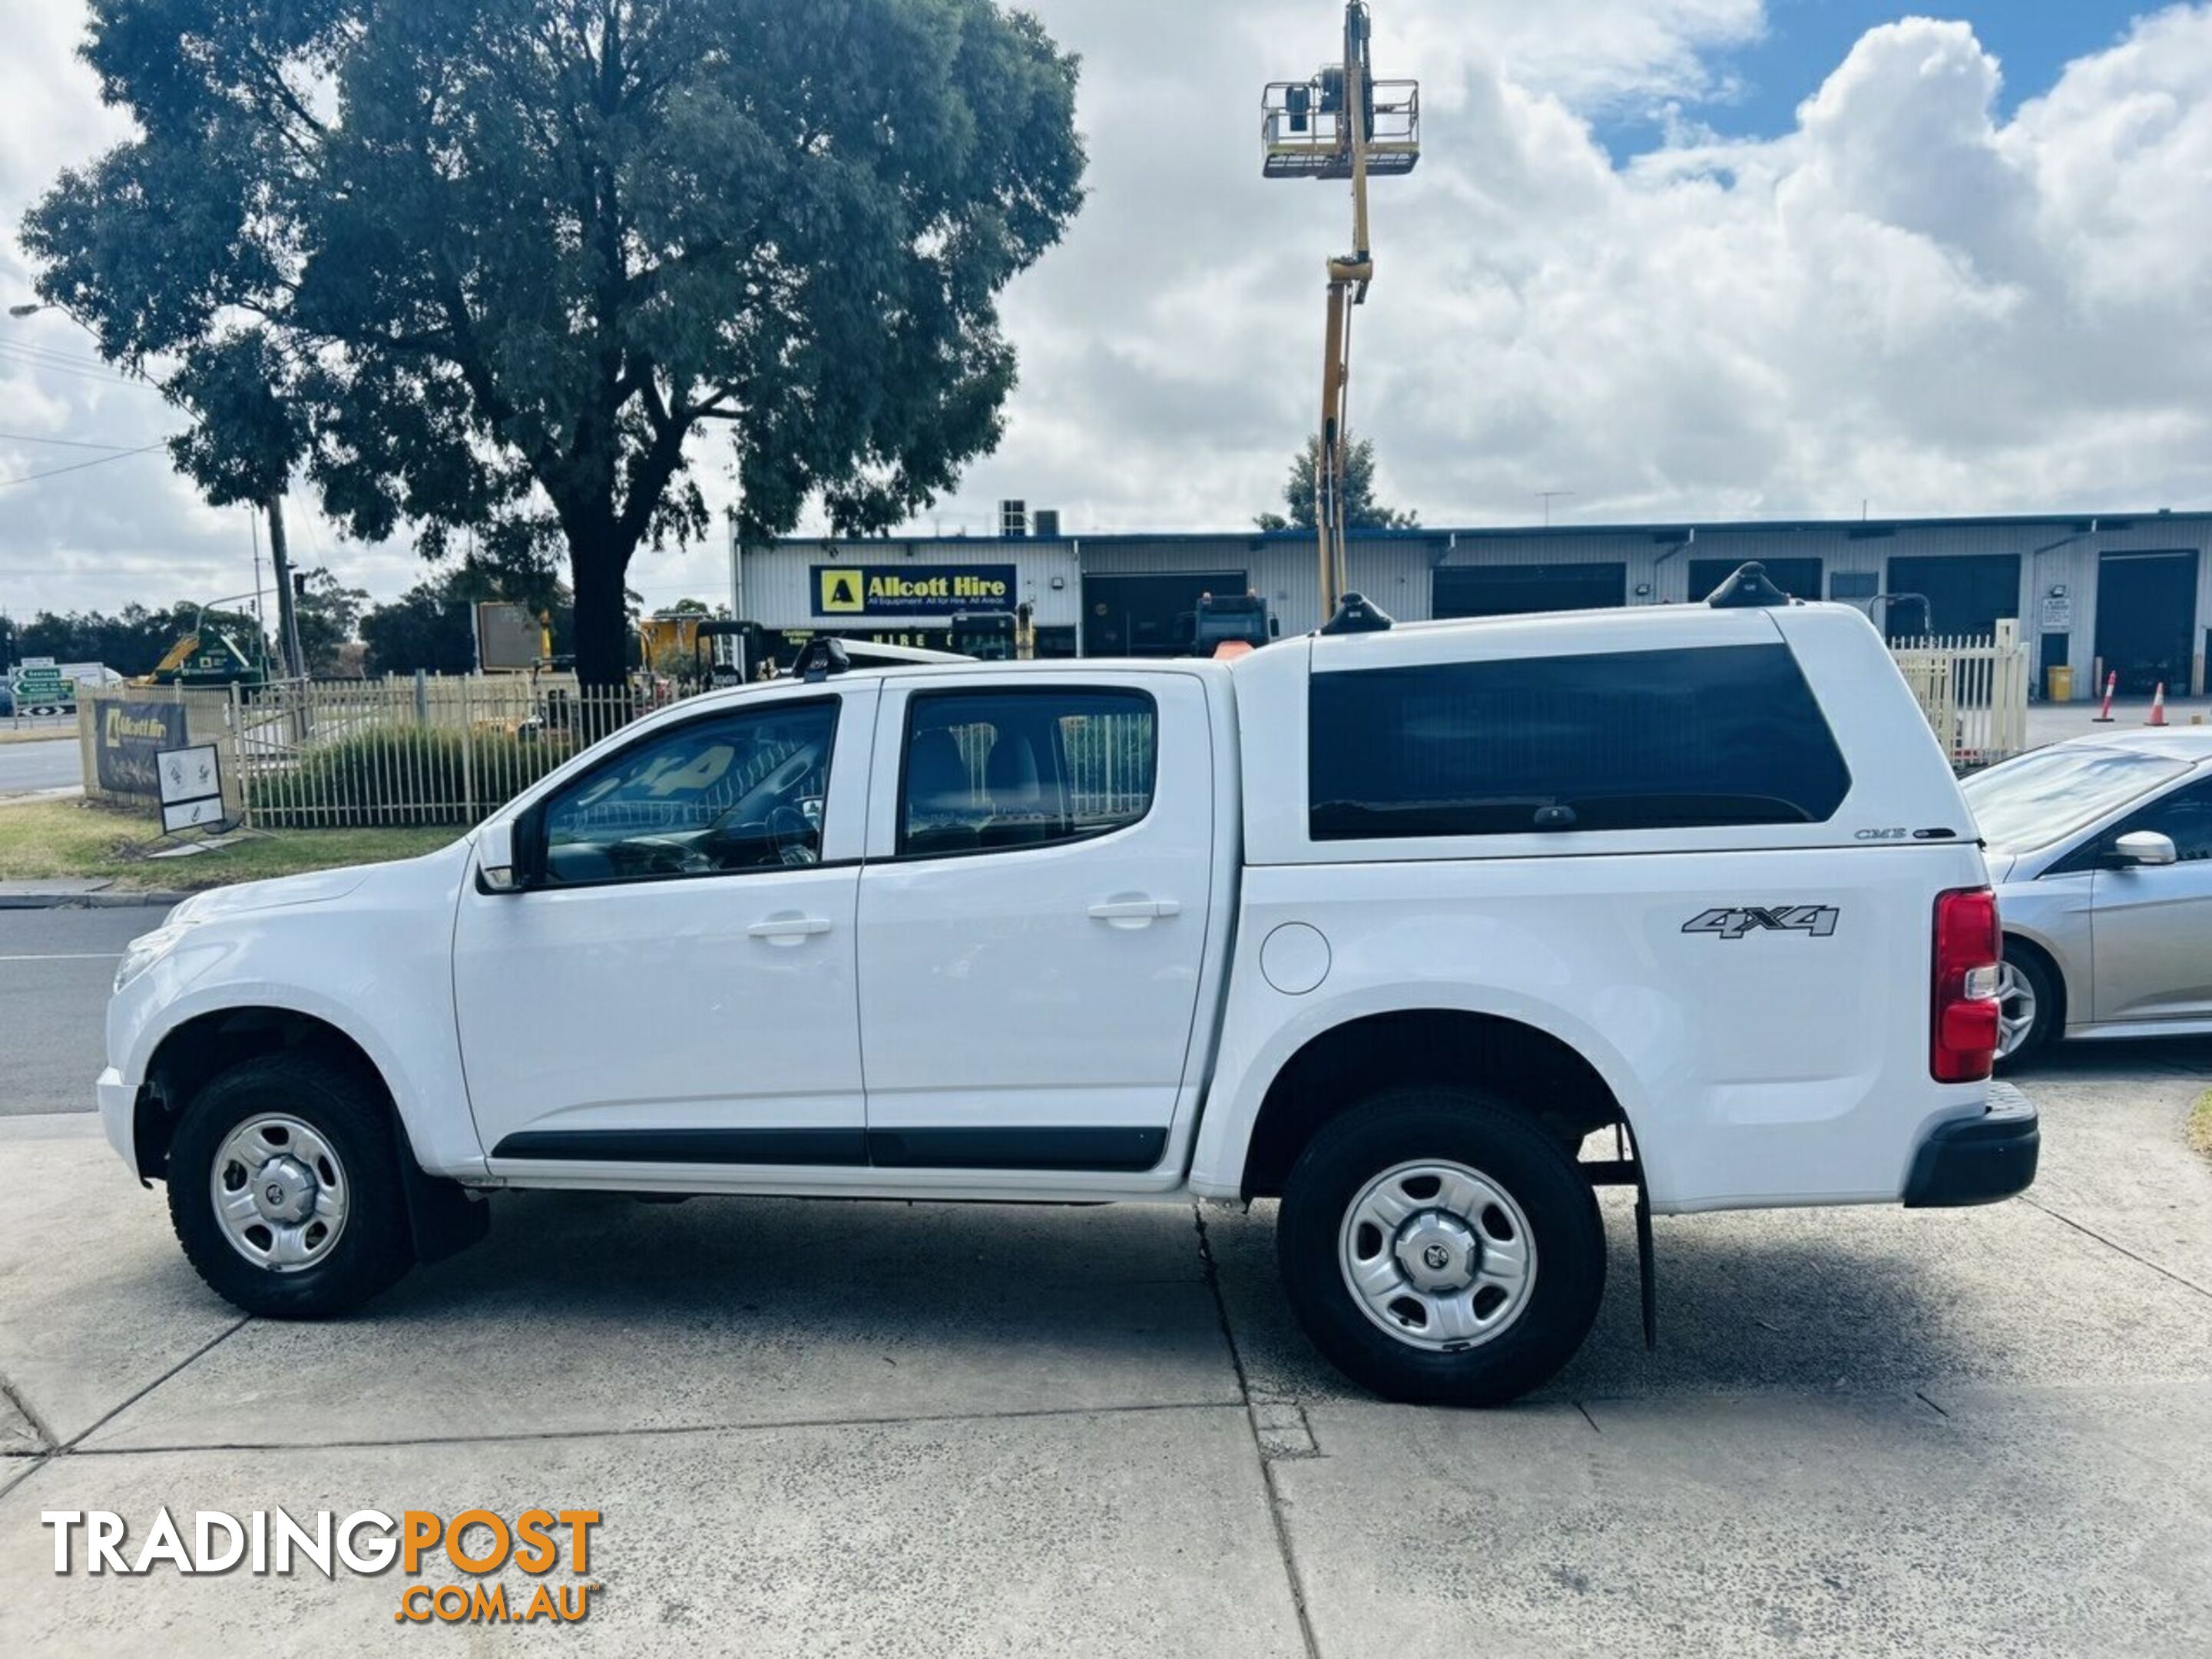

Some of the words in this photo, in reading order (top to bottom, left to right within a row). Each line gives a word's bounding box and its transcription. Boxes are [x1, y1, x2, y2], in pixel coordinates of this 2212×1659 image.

[868, 577, 949, 597] Allcott
[953, 577, 1006, 597] Hire
[873, 634, 926, 647] HIRE
